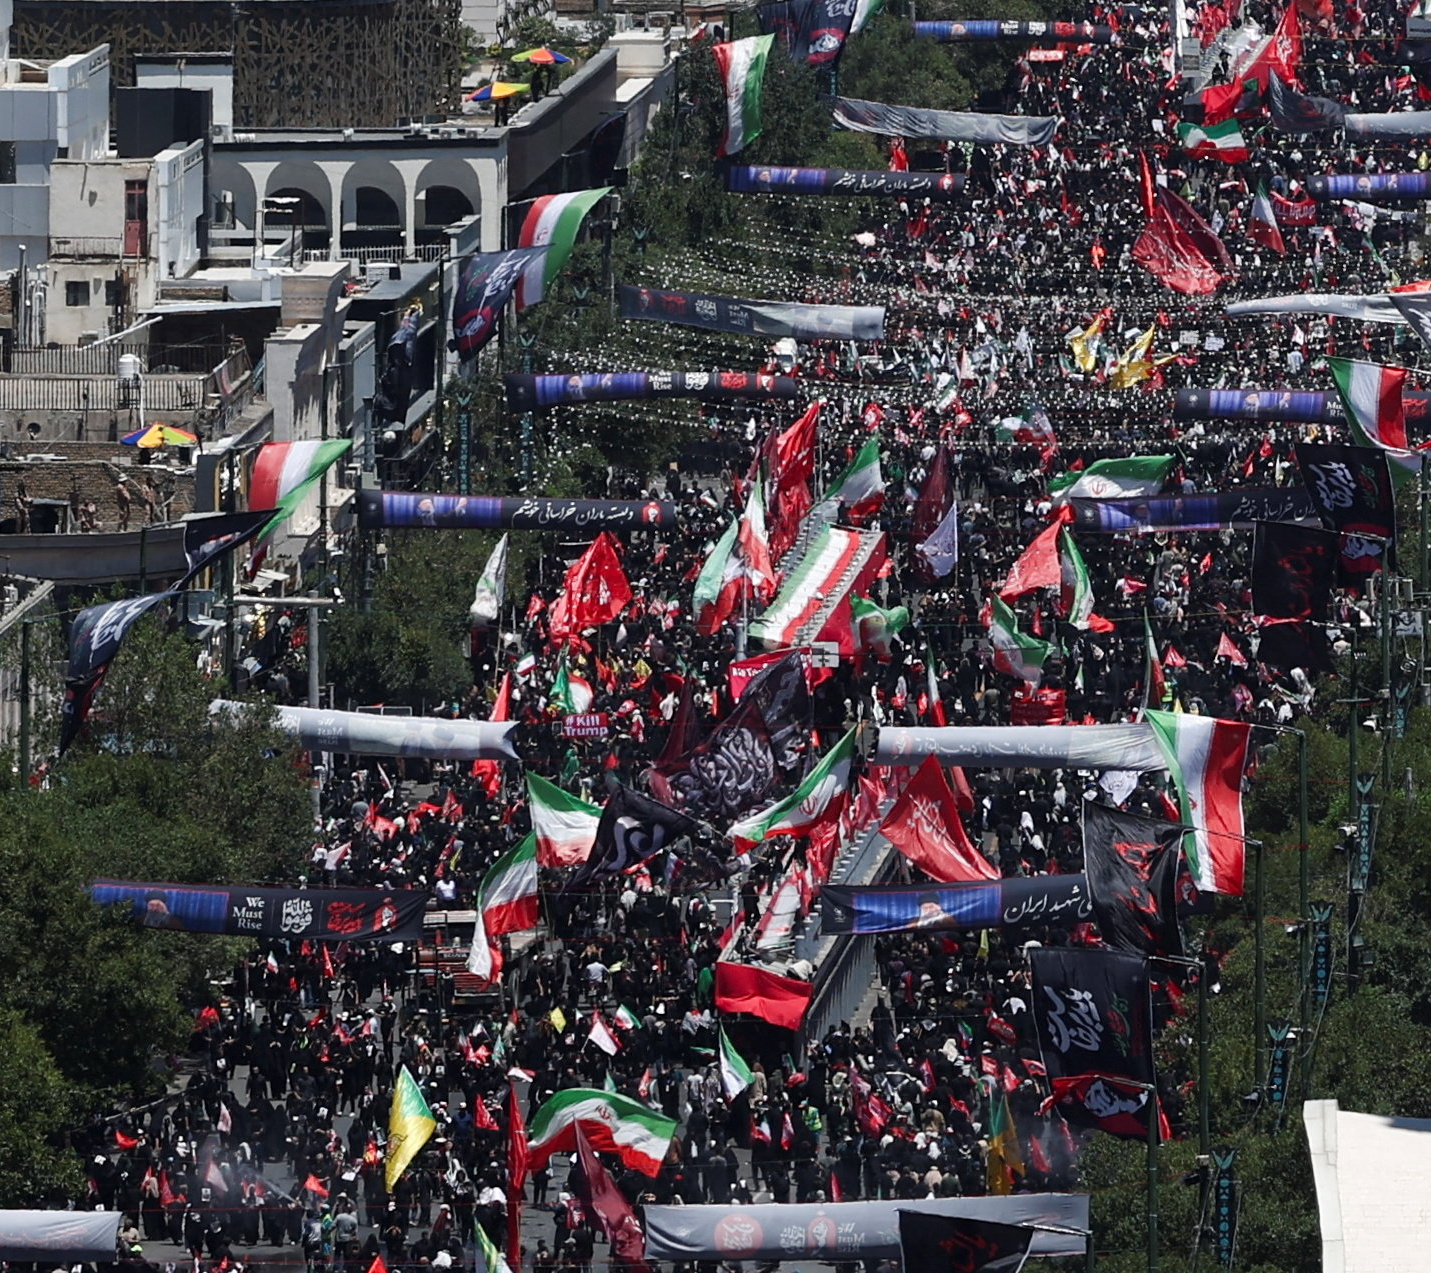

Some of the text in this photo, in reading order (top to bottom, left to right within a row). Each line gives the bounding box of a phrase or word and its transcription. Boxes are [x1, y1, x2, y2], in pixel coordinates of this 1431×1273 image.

[854, 174, 886, 193] خراسانی
[511, 499, 634, 528] دلبسته یاران خراسانی خویشم
[564, 726, 608, 738] Trump
[246, 897, 265, 909] We
[1003, 893, 1047, 923] ایران
[1048, 885, 1081, 920] شهید
[233, 908, 263, 920] Must
[238, 919, 263, 931] Rise
